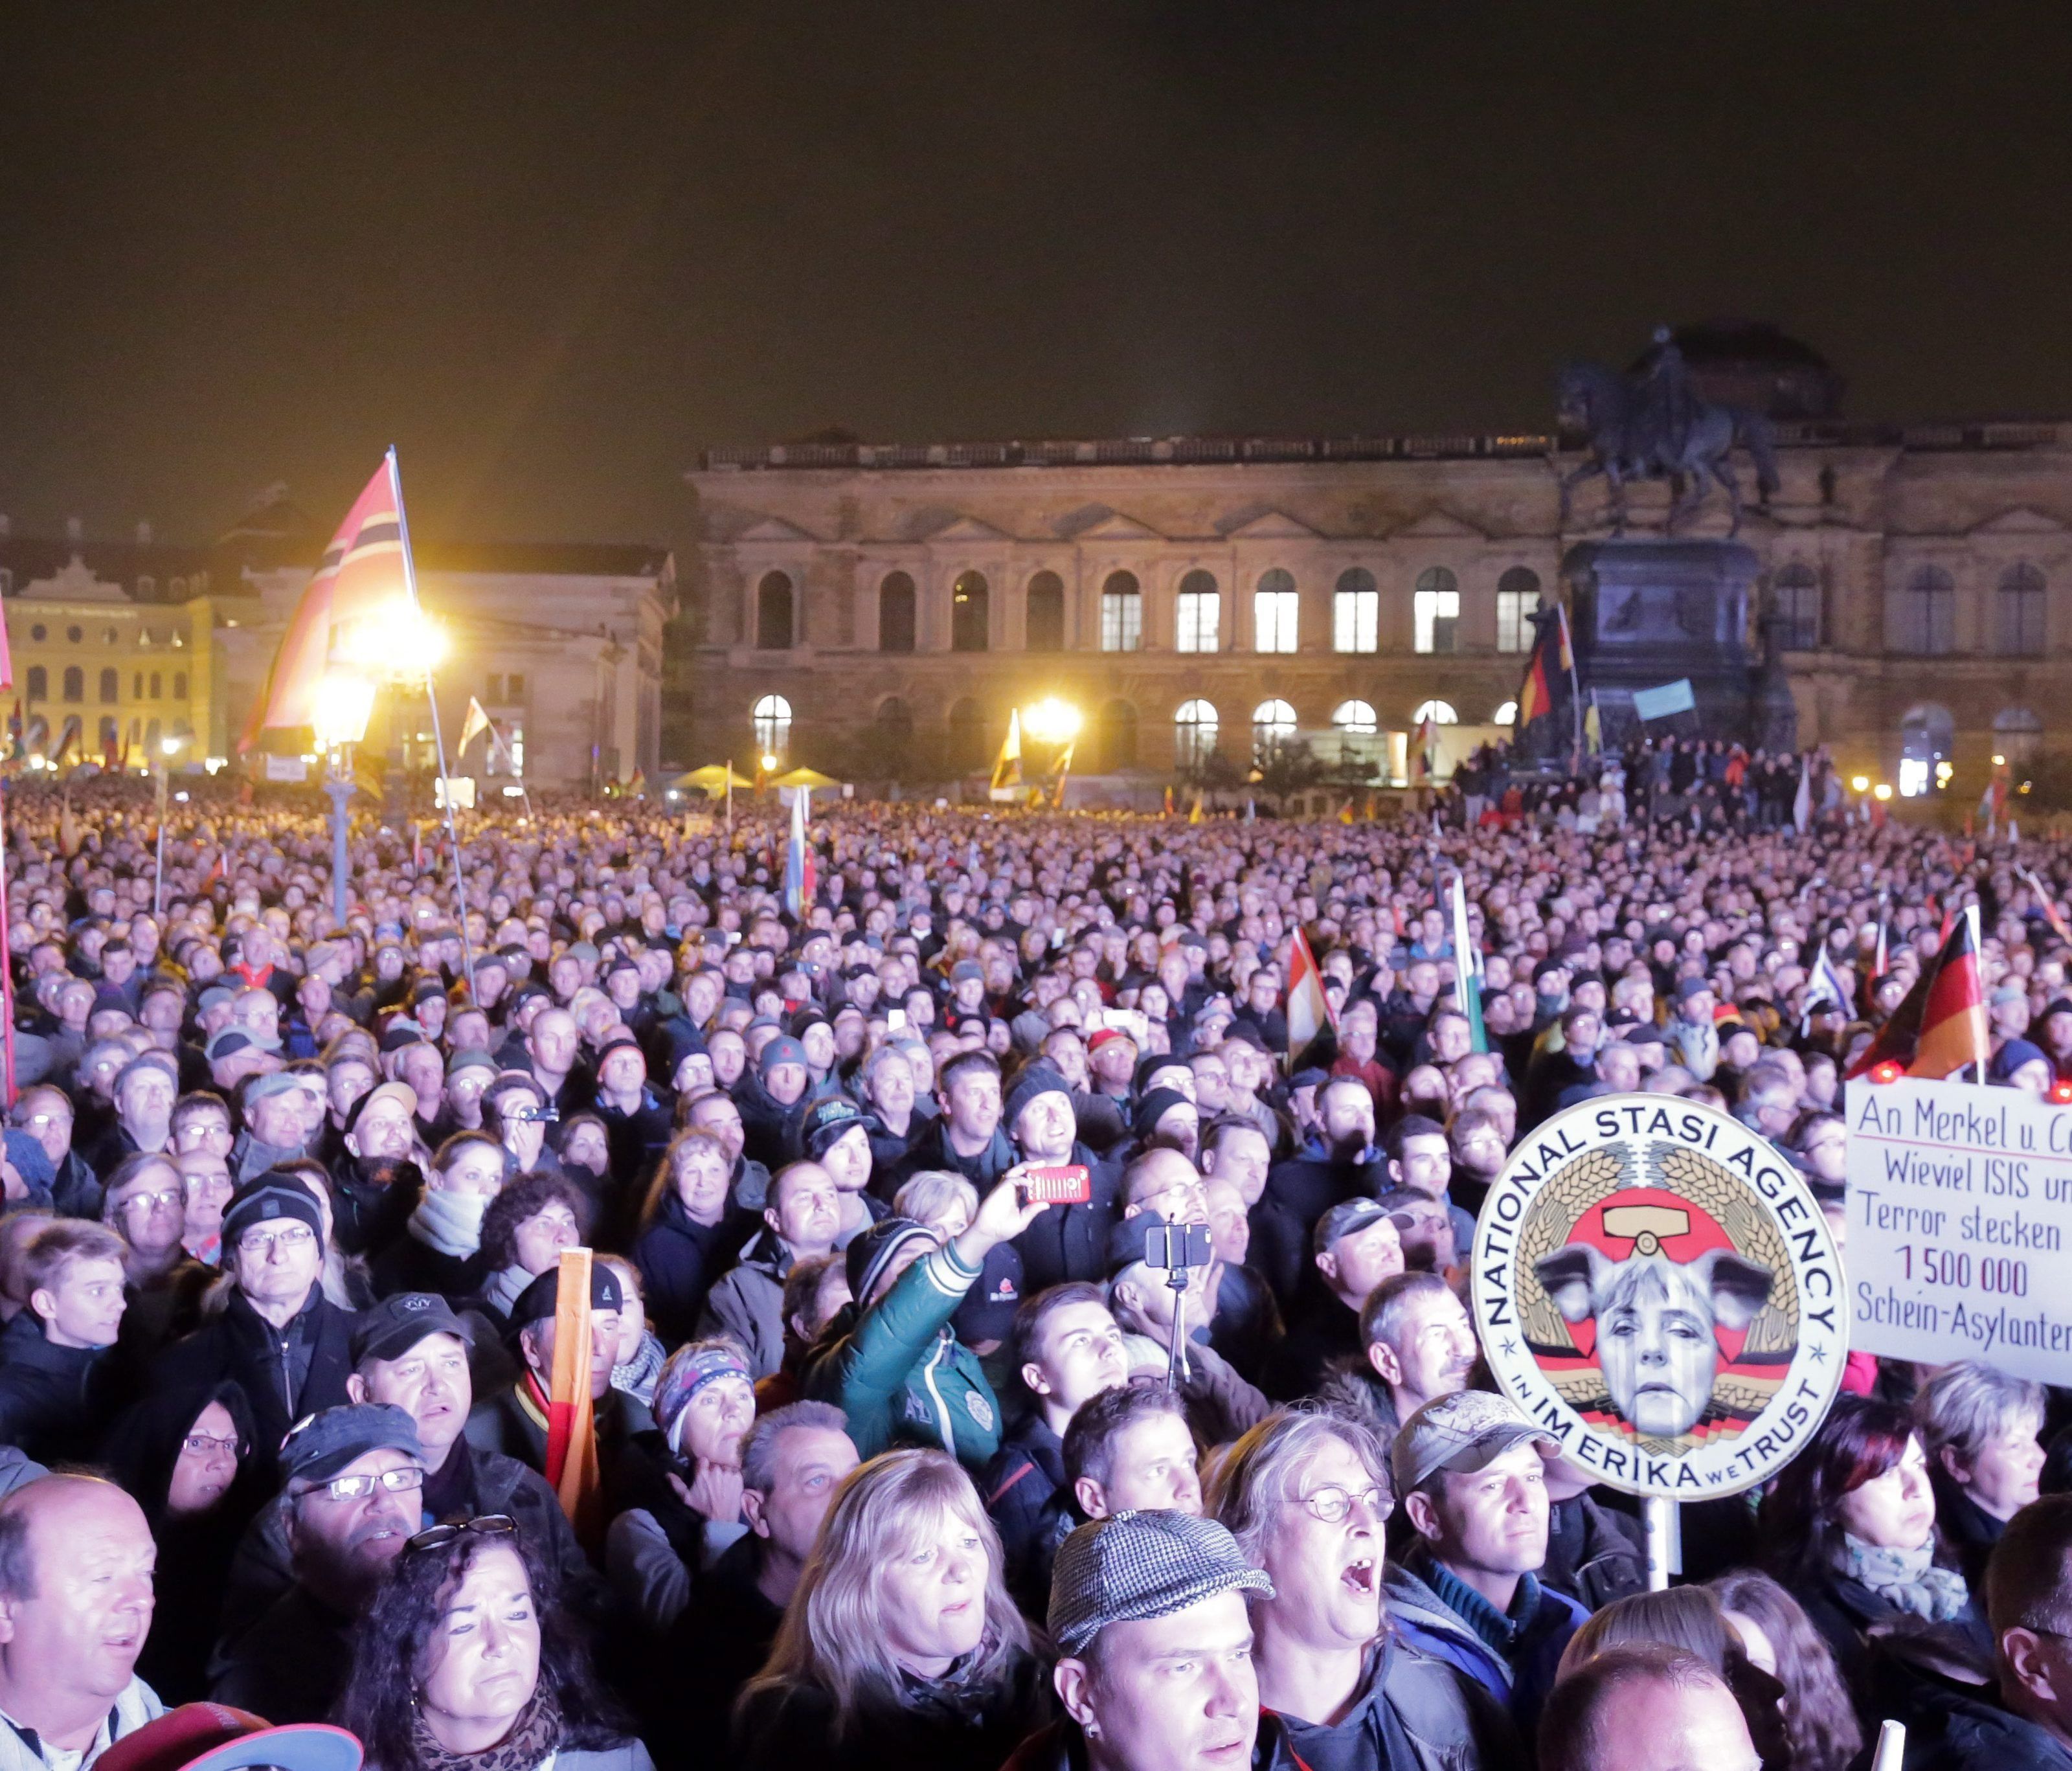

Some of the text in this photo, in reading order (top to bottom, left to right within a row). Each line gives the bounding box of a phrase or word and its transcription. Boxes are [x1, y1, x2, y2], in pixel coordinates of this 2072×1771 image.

[1858, 1094, 1902, 1136] An
[1915, 1098, 2007, 1148] Merkel
[1884, 1148, 1972, 1191] Wieviel
[1985, 1158, 2029, 1198] ISIS
[1484, 1106, 1836, 1334] NATIONAL STASI AGENCY
[1857, 1190, 2061, 1252] Terror stecken
[1511, 1373, 1532, 1399] IN
[1705, 1465, 1740, 1485] WE
[1734, 1379, 1821, 1471] TRUST
